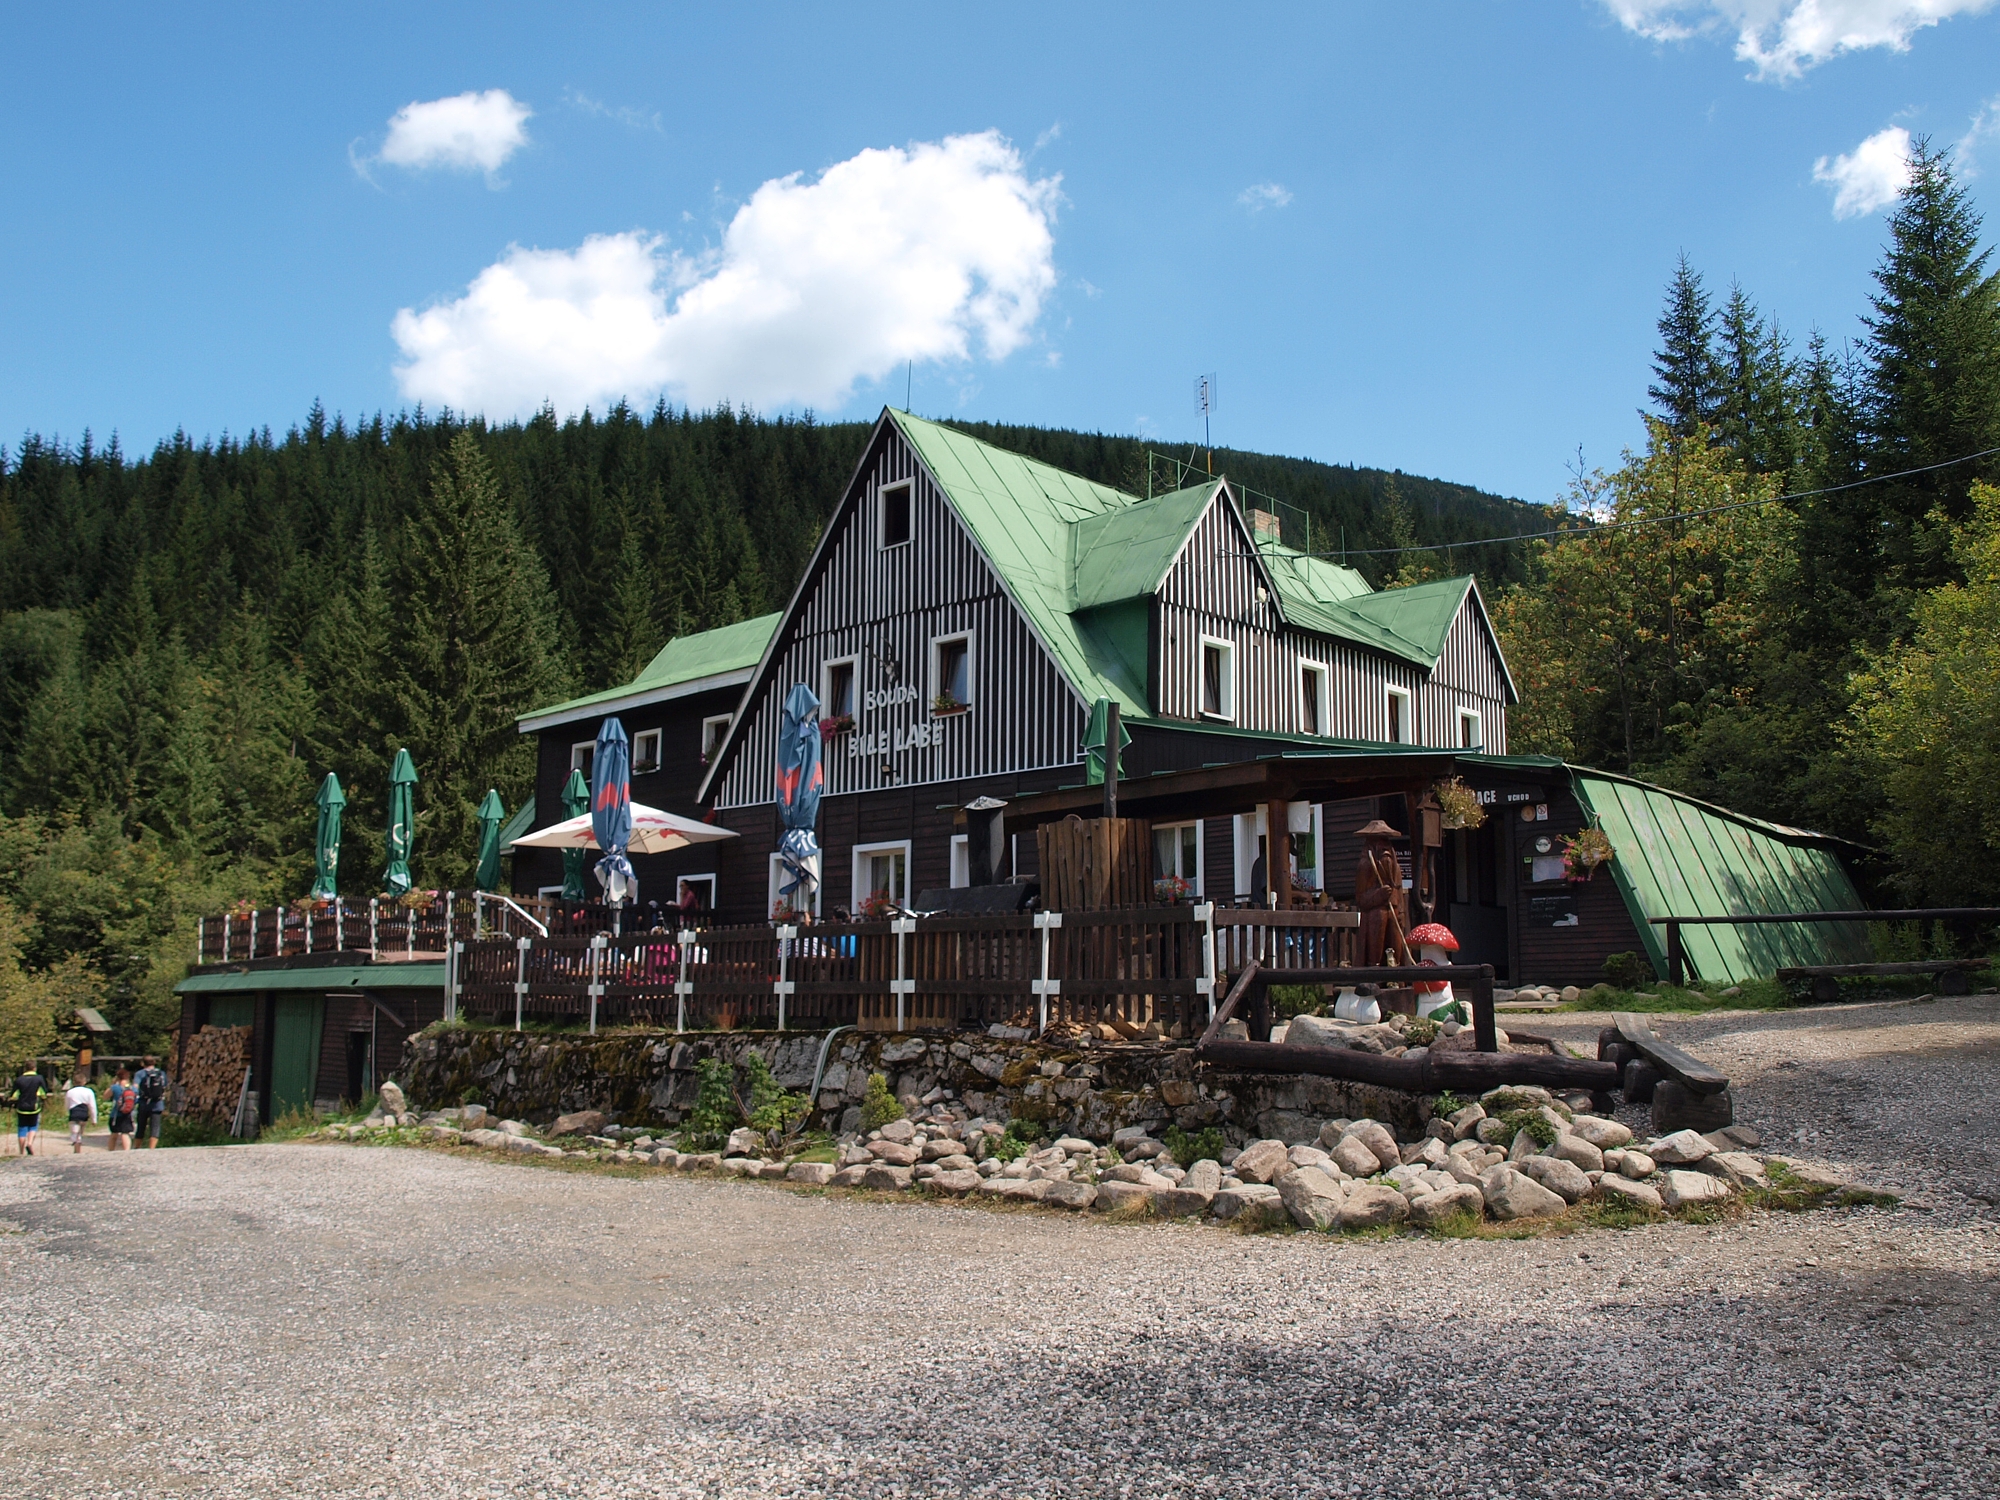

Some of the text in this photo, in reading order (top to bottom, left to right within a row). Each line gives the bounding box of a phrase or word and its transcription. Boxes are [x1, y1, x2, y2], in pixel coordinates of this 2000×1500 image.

[866, 683, 918, 710] BOUDA
[895, 723, 944, 751] LABE
[1476, 790, 1497, 805] ACE
